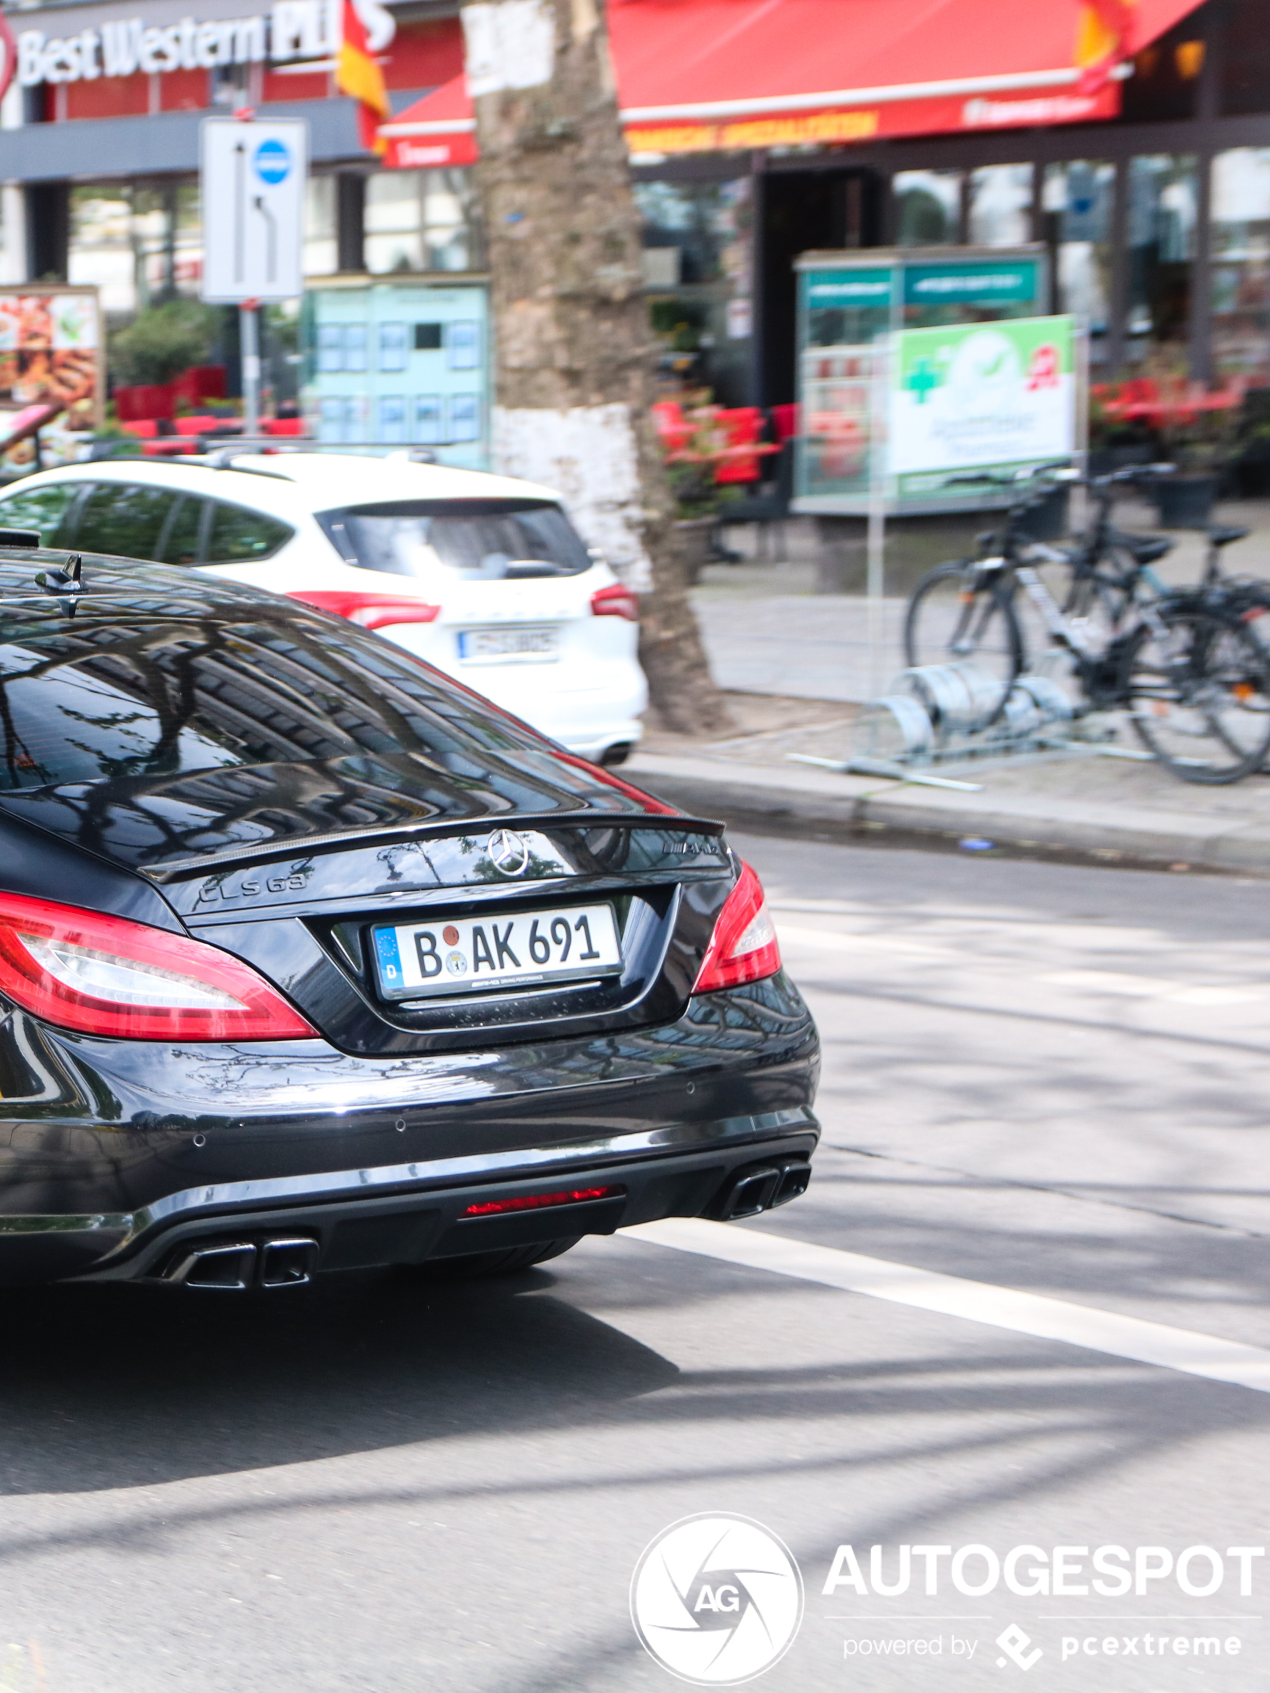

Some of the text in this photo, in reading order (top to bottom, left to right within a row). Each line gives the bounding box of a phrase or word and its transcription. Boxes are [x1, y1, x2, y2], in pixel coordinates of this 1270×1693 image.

[17, 30, 102, 86] Best
[102, 16, 263, 76] Western
[199, 873, 307, 903] CLS 63
[413, 915, 600, 979] B AK 691
[386, 964, 397, 979] D
